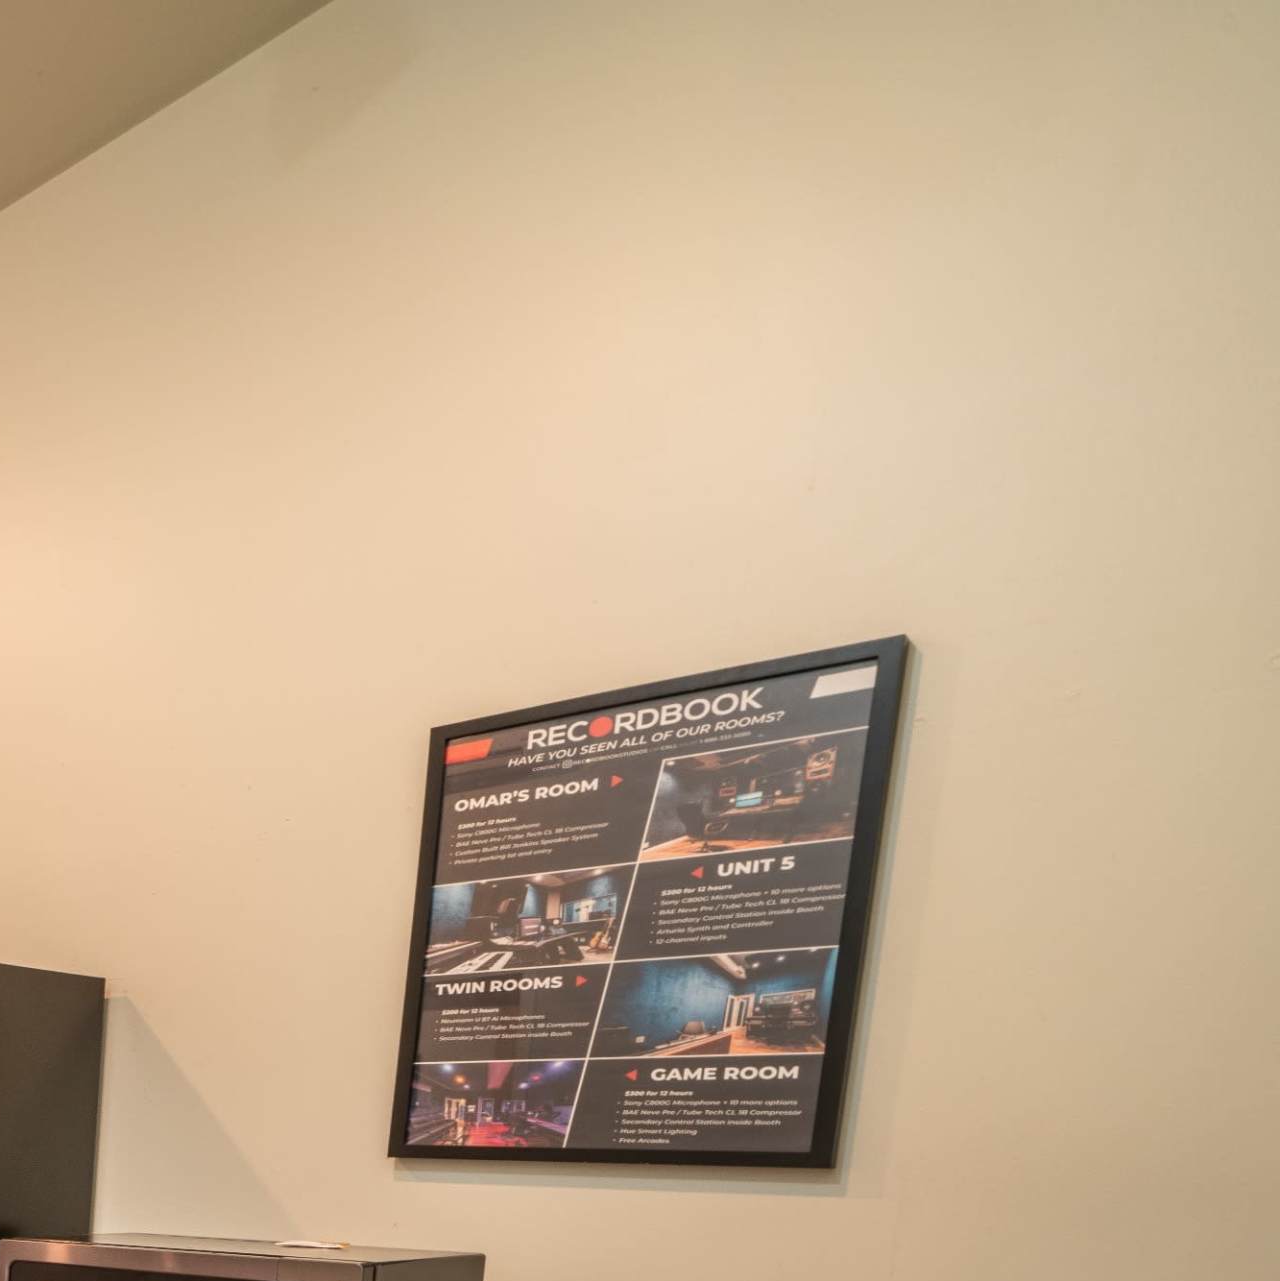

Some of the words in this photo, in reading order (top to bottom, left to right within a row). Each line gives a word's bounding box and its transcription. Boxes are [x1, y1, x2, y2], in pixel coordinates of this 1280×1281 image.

[526, 687, 765, 750] RECORDBOOK
[507, 752, 545, 769] HAVE
[548, 747, 577, 760] YOU
[579, 740, 618, 755] SEEN
[619, 735, 648, 748] ALL
[651, 730, 674, 743] OF
[676, 721, 712, 739] OUR
[714, 710, 786, 732] ROOMS?
[454, 788, 530, 813] OMAR'S
[534, 778, 600, 800] ROOM
[716, 858, 775, 878] UNIT
[780, 856, 796, 871] 5
[707, 884, 733, 892] hours
[711, 892, 761, 900] Microphone
[435, 981, 485, 996] TWIN
[489, 975, 564, 993] ROOMS
[650, 1066, 717, 1082] GAME
[723, 1065, 800, 1082] ROOM
